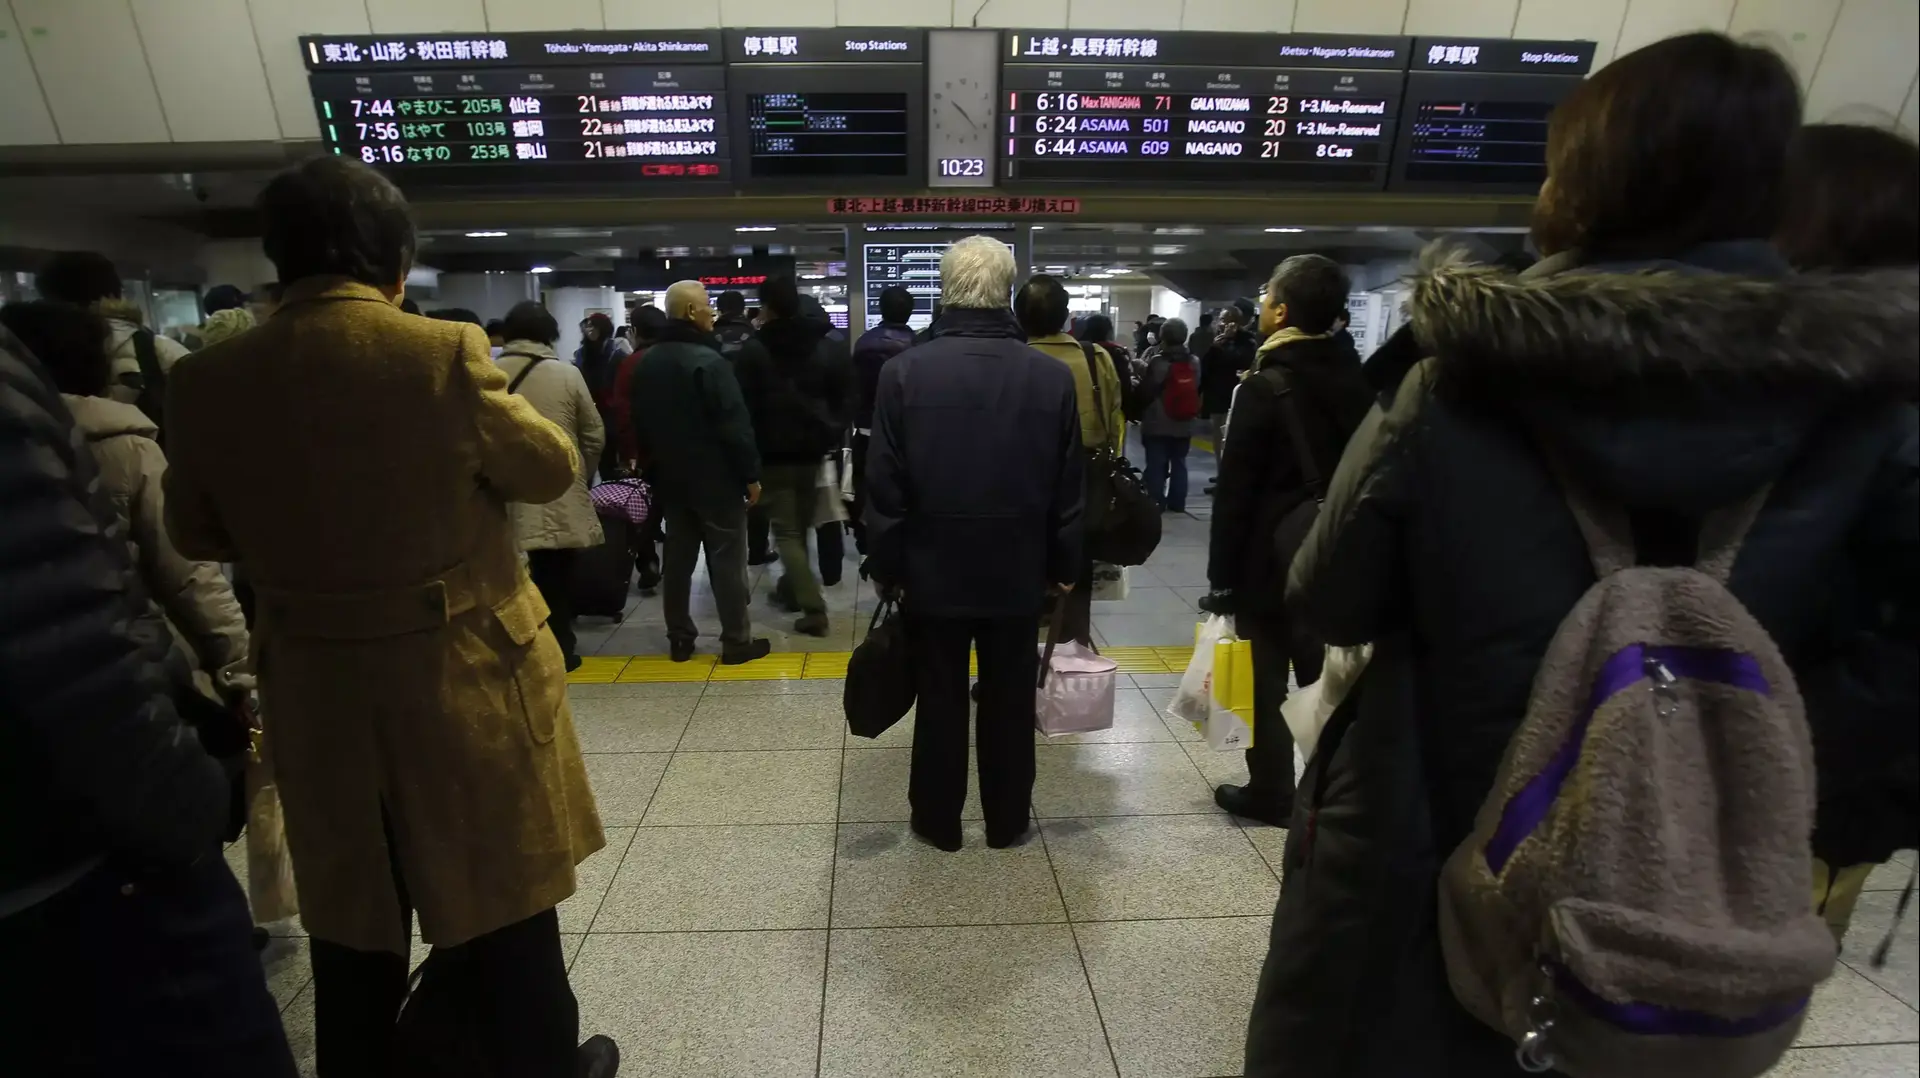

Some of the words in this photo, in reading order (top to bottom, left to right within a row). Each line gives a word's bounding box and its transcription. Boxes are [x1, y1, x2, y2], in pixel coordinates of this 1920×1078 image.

[658, 42, 709, 52] Shinkansen
[744, 36, 798, 55] 停車駅
[845, 40, 868, 52] Stop
[868, 41, 908, 51] Stations
[1024, 36, 1158, 58] 上越・長野新幹線
[1347, 47, 1396, 58] Shinkansen
[1428, 45, 1480, 65] 停車駅
[1521, 52, 1543, 64] Stop
[1542, 53, 1579, 63] Stations
[350, 100, 395, 117] 7:44
[398, 101, 457, 115] やまびこ
[462, 99, 503, 114] 205号
[509, 97, 541, 114] 仙台
[1037, 94, 1078, 111] 6:16
[1081, 96, 1099, 109] Max
[1099, 96, 1141, 109] TANIGAWA
[1155, 97, 1171, 110] 71
[1190, 98, 1213, 112] GALA
[1214, 98, 1250, 112] YUZAWA
[1267, 97, 1288, 114] 23
[1320, 101, 1384, 115] Non-Reserved
[355, 123, 400, 140] 7:56
[402, 122, 446, 138] はやて
[467, 122, 507, 137] 103号
[513, 120, 544, 137] 盛岡
[1036, 116, 1077, 133] 6:24
[1080, 119, 1130, 132] ASAMA
[1143, 119, 1169, 133] 501
[1188, 121, 1245, 134] NAGANO
[1264, 120, 1286, 136] 20
[1317, 123, 1380, 136] Non-Reserved
[361, 146, 404, 163] 8:16
[406, 145, 451, 161] なすの
[469, 144, 510, 160] 253号
[515, 142, 547, 160] 郡山
[1035, 139, 1076, 155] 6:44
[1078, 141, 1128, 154] ASAMA
[1141, 141, 1169, 155] 609
[1185, 143, 1242, 156] NAGANO
[1261, 142, 1280, 158] 21
[1316, 145, 1327, 157] 8
[1328, 145, 1353, 158] Cars
[941, 159, 983, 176] 10:23
